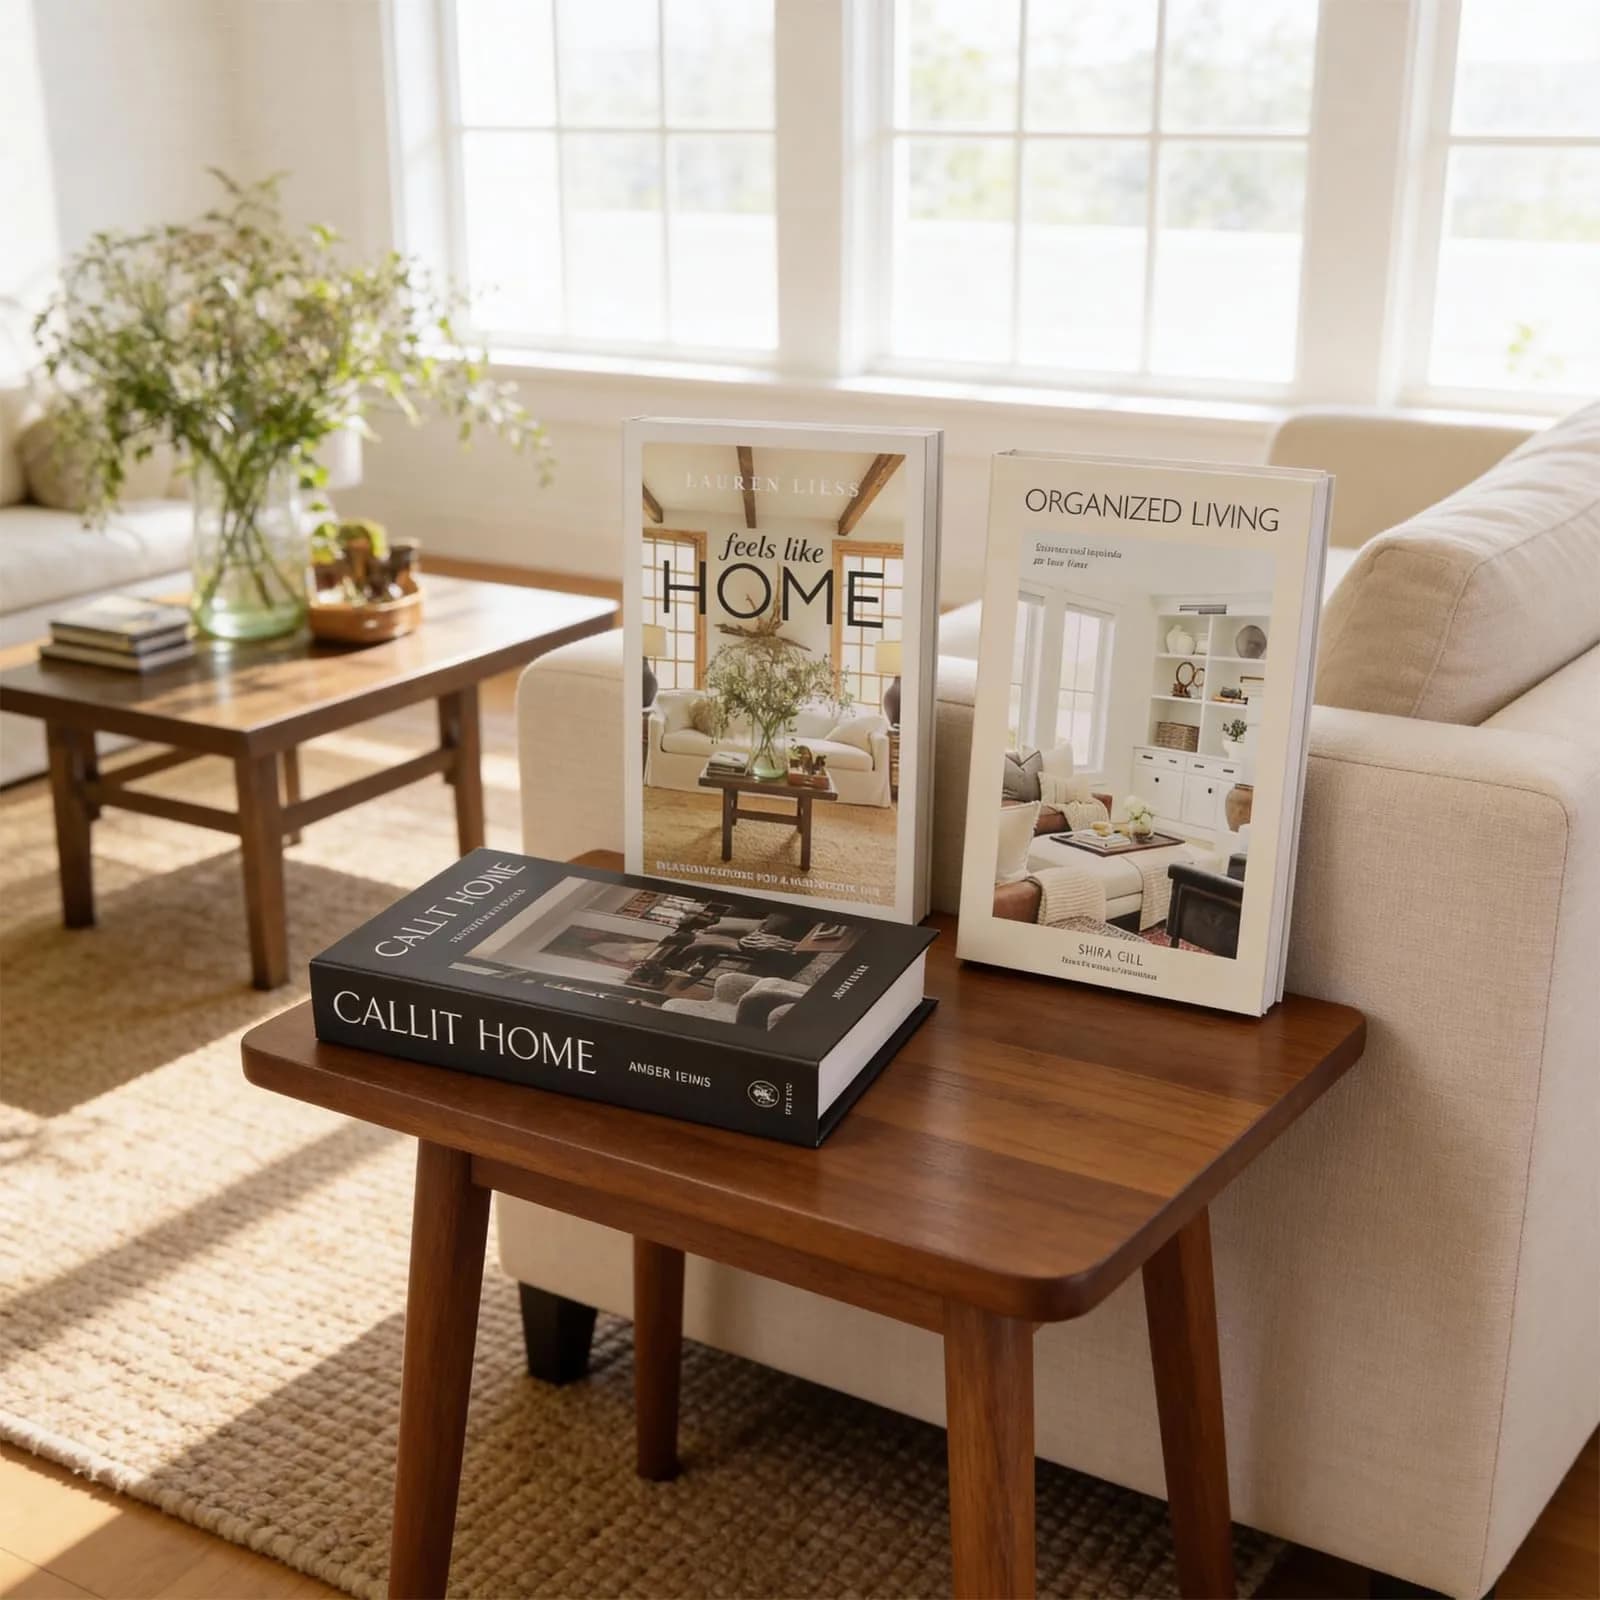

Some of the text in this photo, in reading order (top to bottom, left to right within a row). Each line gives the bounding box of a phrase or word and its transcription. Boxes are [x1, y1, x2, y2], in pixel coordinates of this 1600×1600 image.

[686, 472, 779, 493] LAUREN
[1025, 488, 1280, 532] ORGANIZED LIVING
[718, 532, 824, 563] feels like
[663, 560, 884, 628] HOME
[1078, 943, 1113, 960] SHIRA
[478, 1018, 597, 1075] HOME
